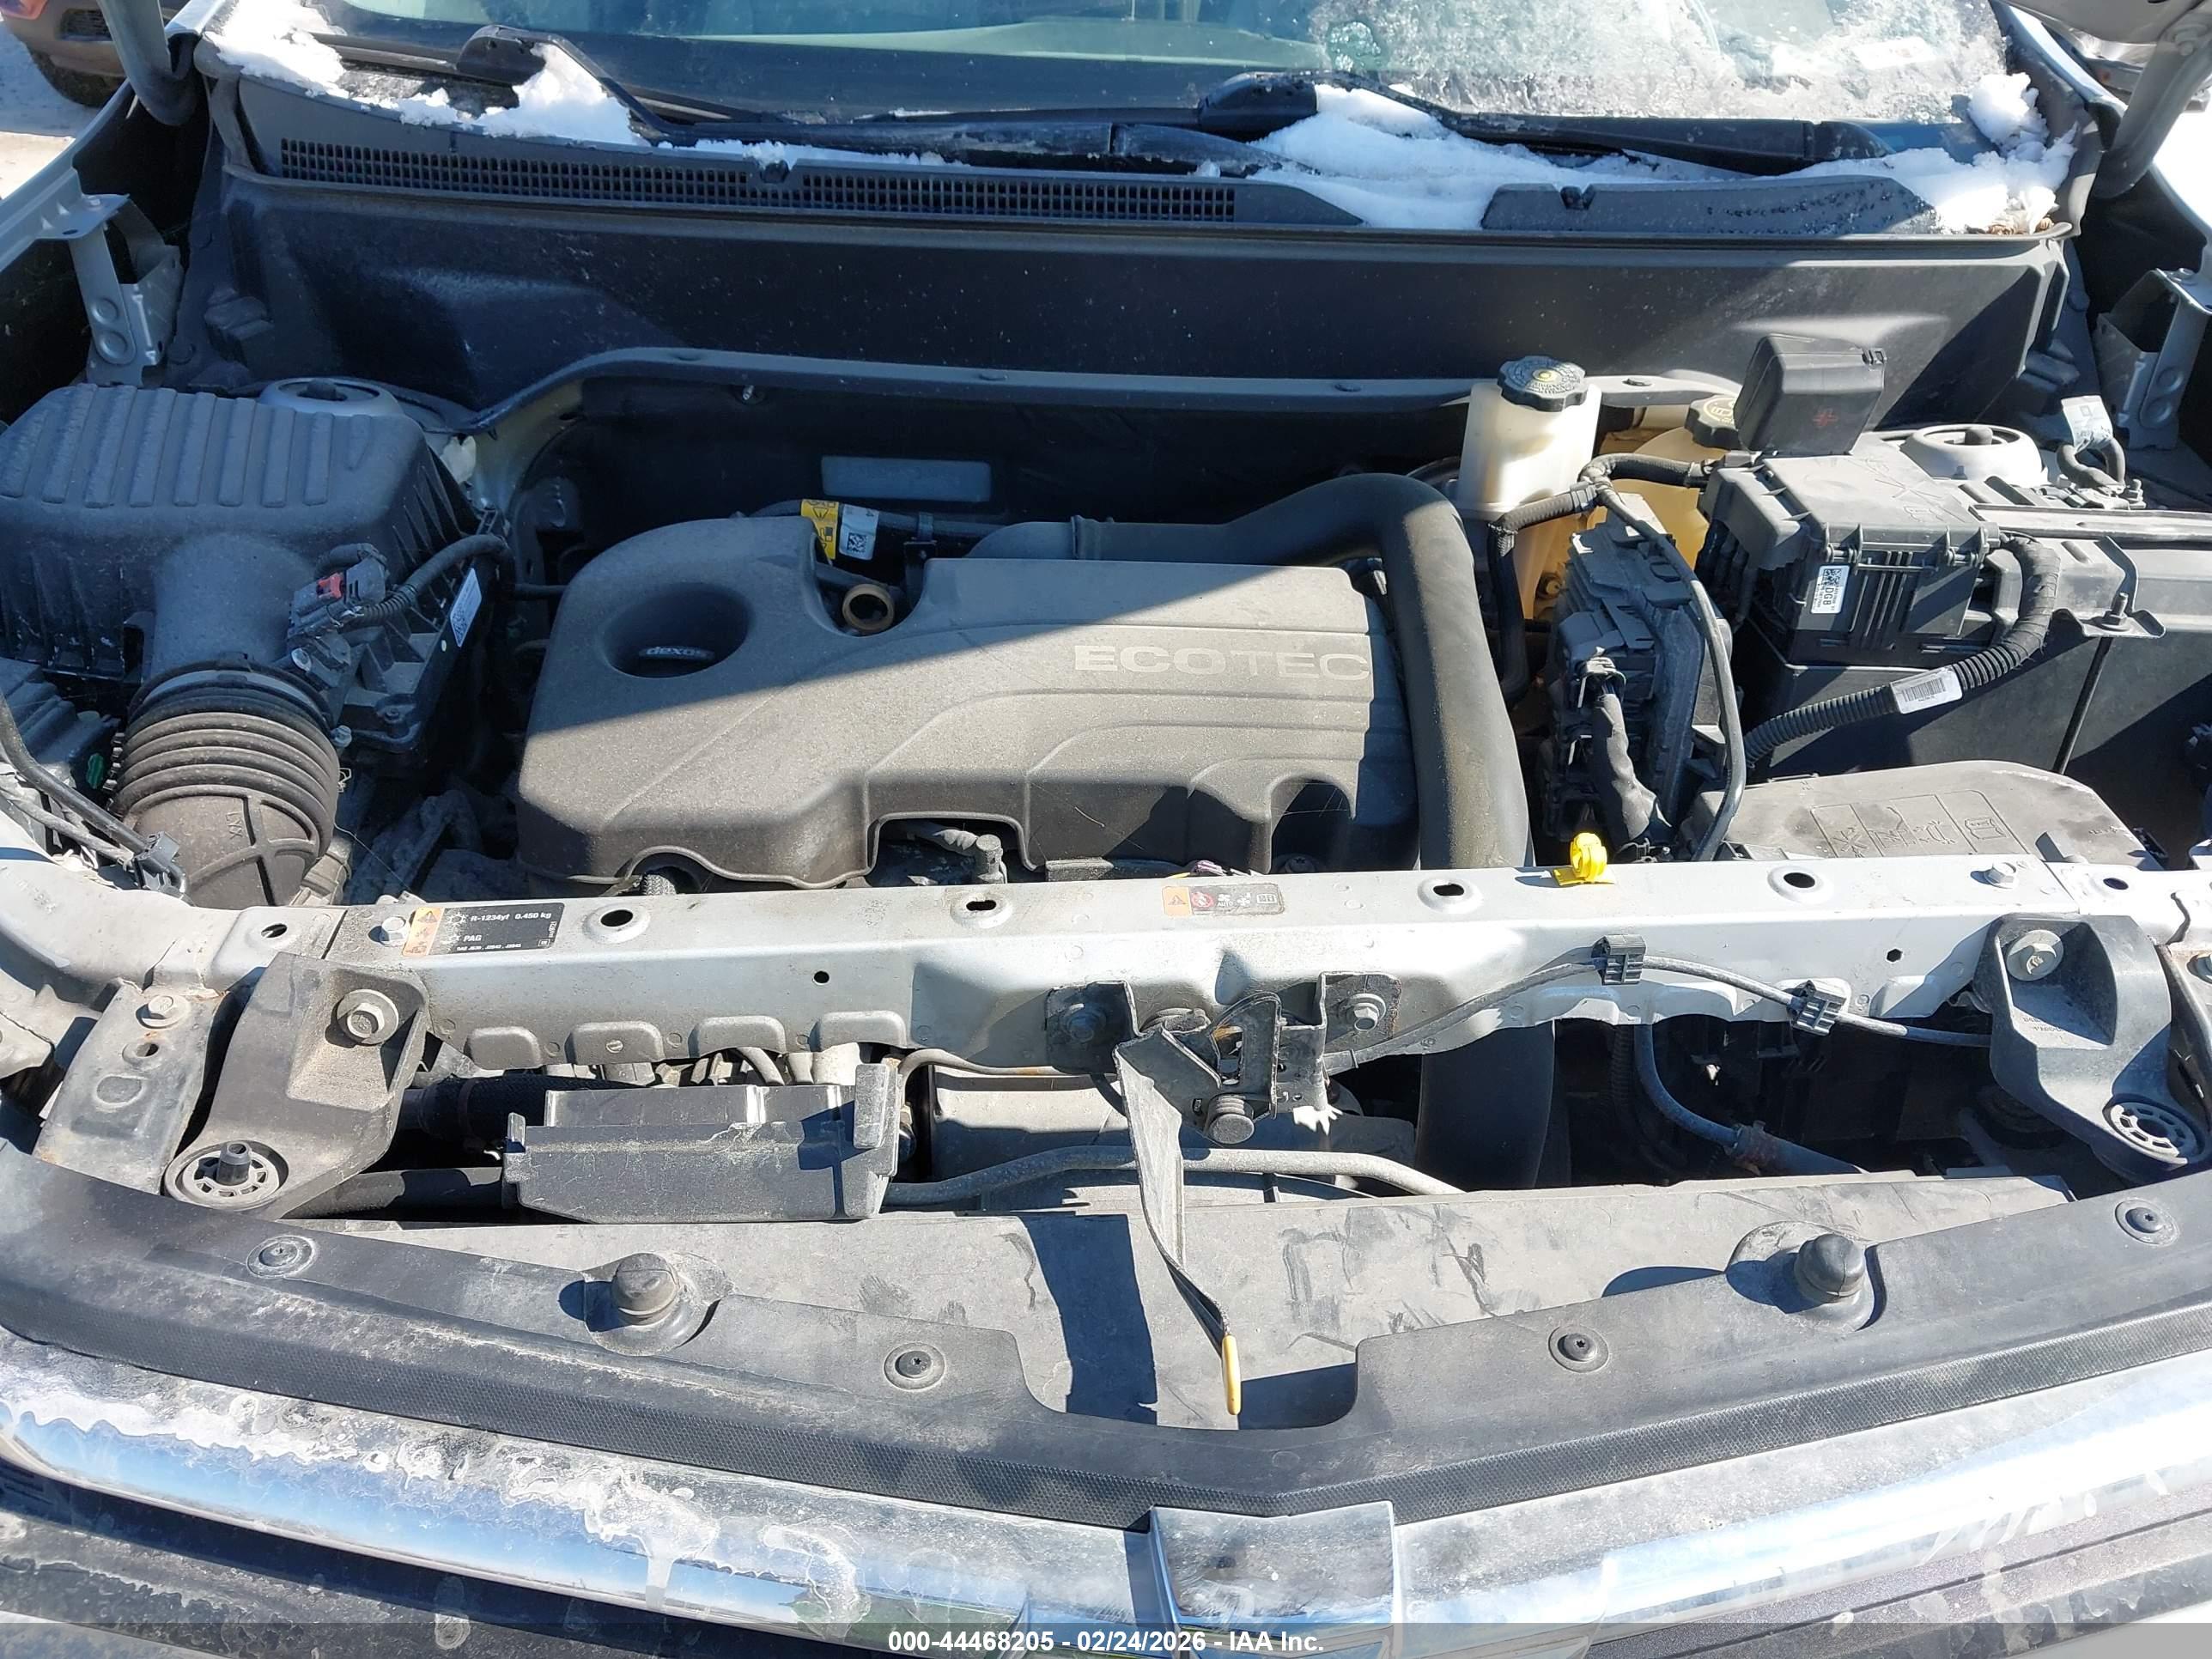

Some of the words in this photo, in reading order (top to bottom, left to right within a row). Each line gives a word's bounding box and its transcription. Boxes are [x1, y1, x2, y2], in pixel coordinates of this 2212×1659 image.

[1074, 645, 1370, 681] ECOTEC
[471, 913, 510, 922] R-1234yf
[514, 912, 538, 921] 0.450
